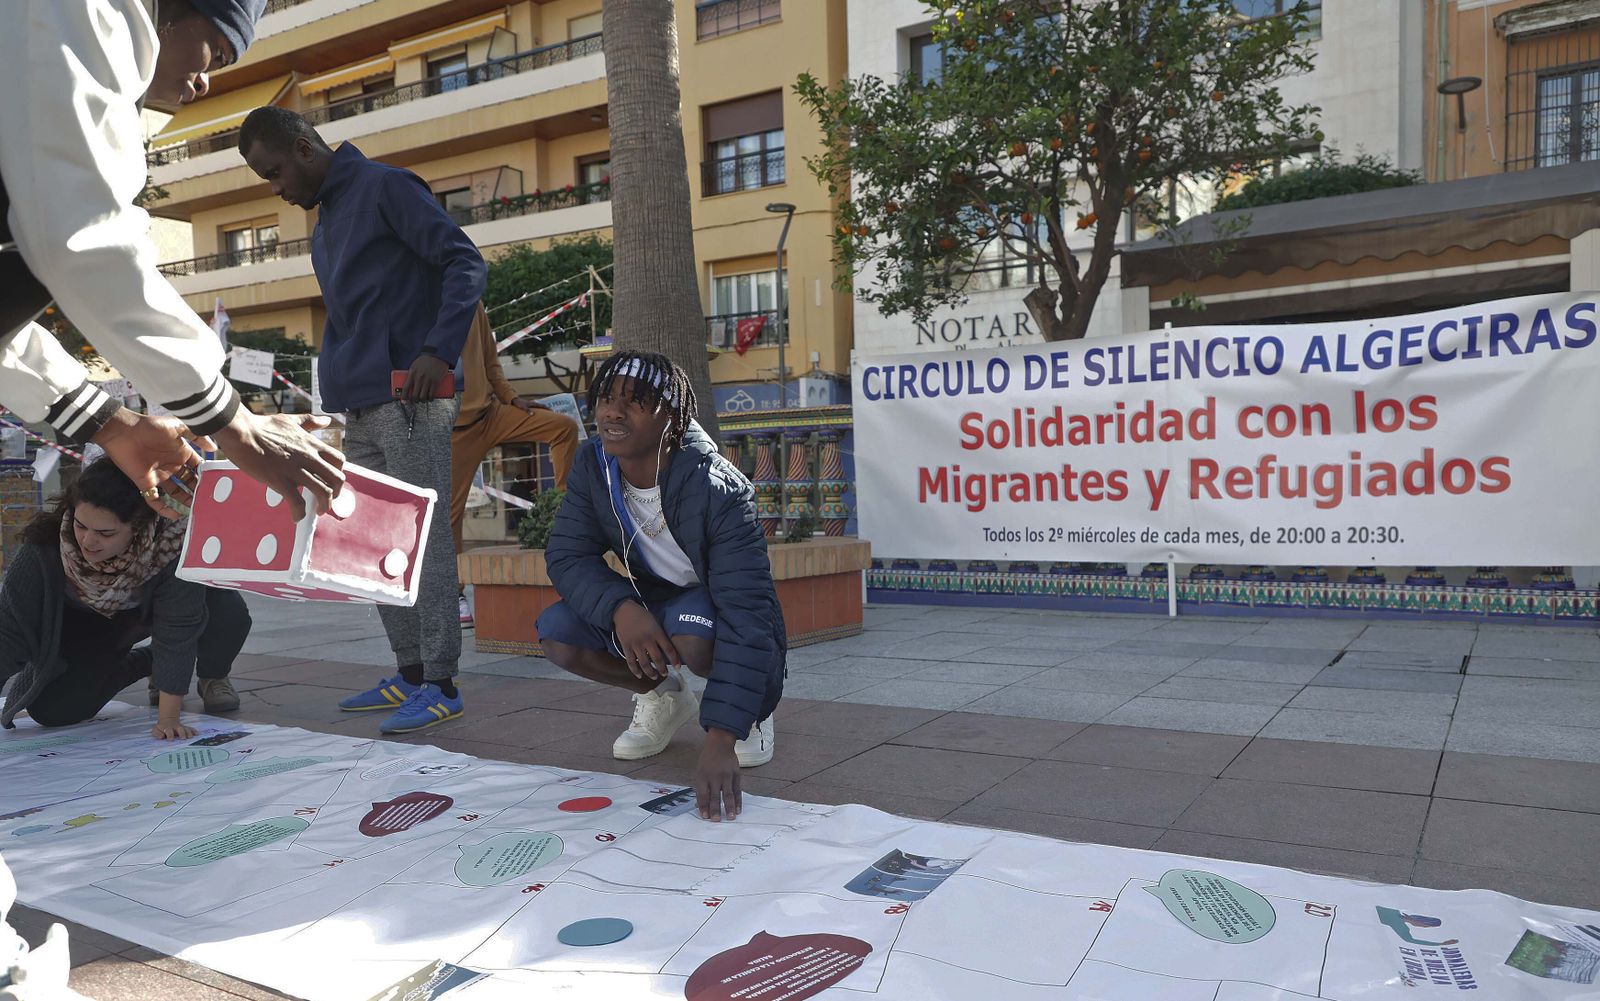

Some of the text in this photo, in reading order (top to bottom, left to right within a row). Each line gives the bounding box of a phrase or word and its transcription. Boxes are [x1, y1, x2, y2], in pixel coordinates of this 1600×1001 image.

[915, 312, 1042, 345] NOTAR
[864, 303, 1598, 401] CIRCULO DE SILENCIO ALGECIRAS
[961, 391, 1436, 450] Solidaridad con los
[920, 448, 1509, 512] Migrantes y Refugiados
[983, 527, 1021, 543] Todos
[1025, 527, 1044, 543] los
[1068, 526, 1136, 543] miércoles
[1140, 527, 1159, 544] de
[1164, 526, 1200, 544] cada
[1206, 531, 1245, 547] mes,
[1250, 527, 1271, 544] de
[1277, 527, 1326, 544] 20:00
[1331, 531, 1341, 544] a
[1347, 526, 1405, 544] 20:30.
[884, 903, 909, 914] 18
[1088, 900, 1112, 912] 19
[1304, 903, 1331, 917] 20
[1420, 948, 1439, 958] DE
[1440, 947, 1479, 990] JORNALERAS
